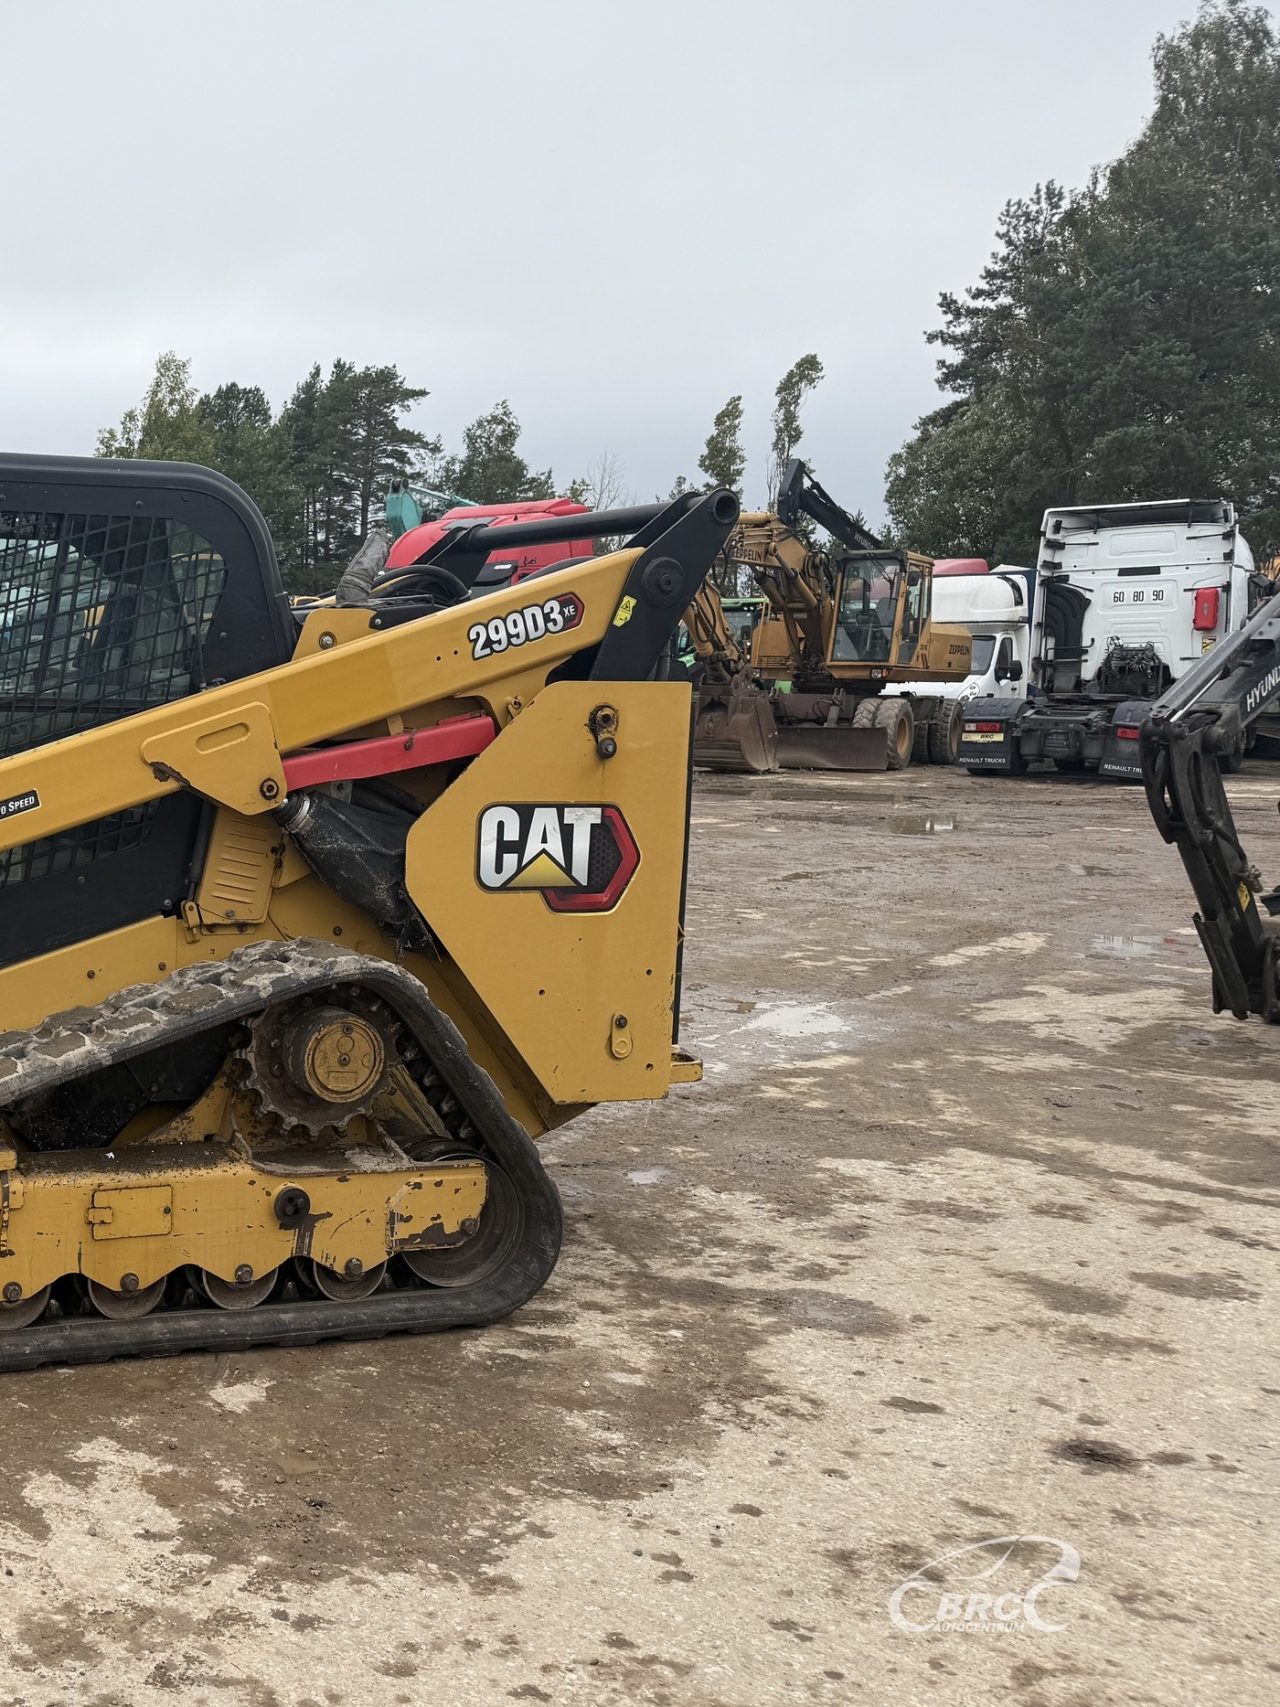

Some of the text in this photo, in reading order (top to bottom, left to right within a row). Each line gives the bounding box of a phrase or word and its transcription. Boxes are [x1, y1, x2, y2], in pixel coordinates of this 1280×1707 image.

[1113, 589, 1164, 602] 60 80 90
[469, 600, 576, 660] 299D3 XE
[948, 644, 970, 656] ZEPPELIN
[1103, 763, 1132, 772] RENAULT
[479, 805, 602, 888] CAT
